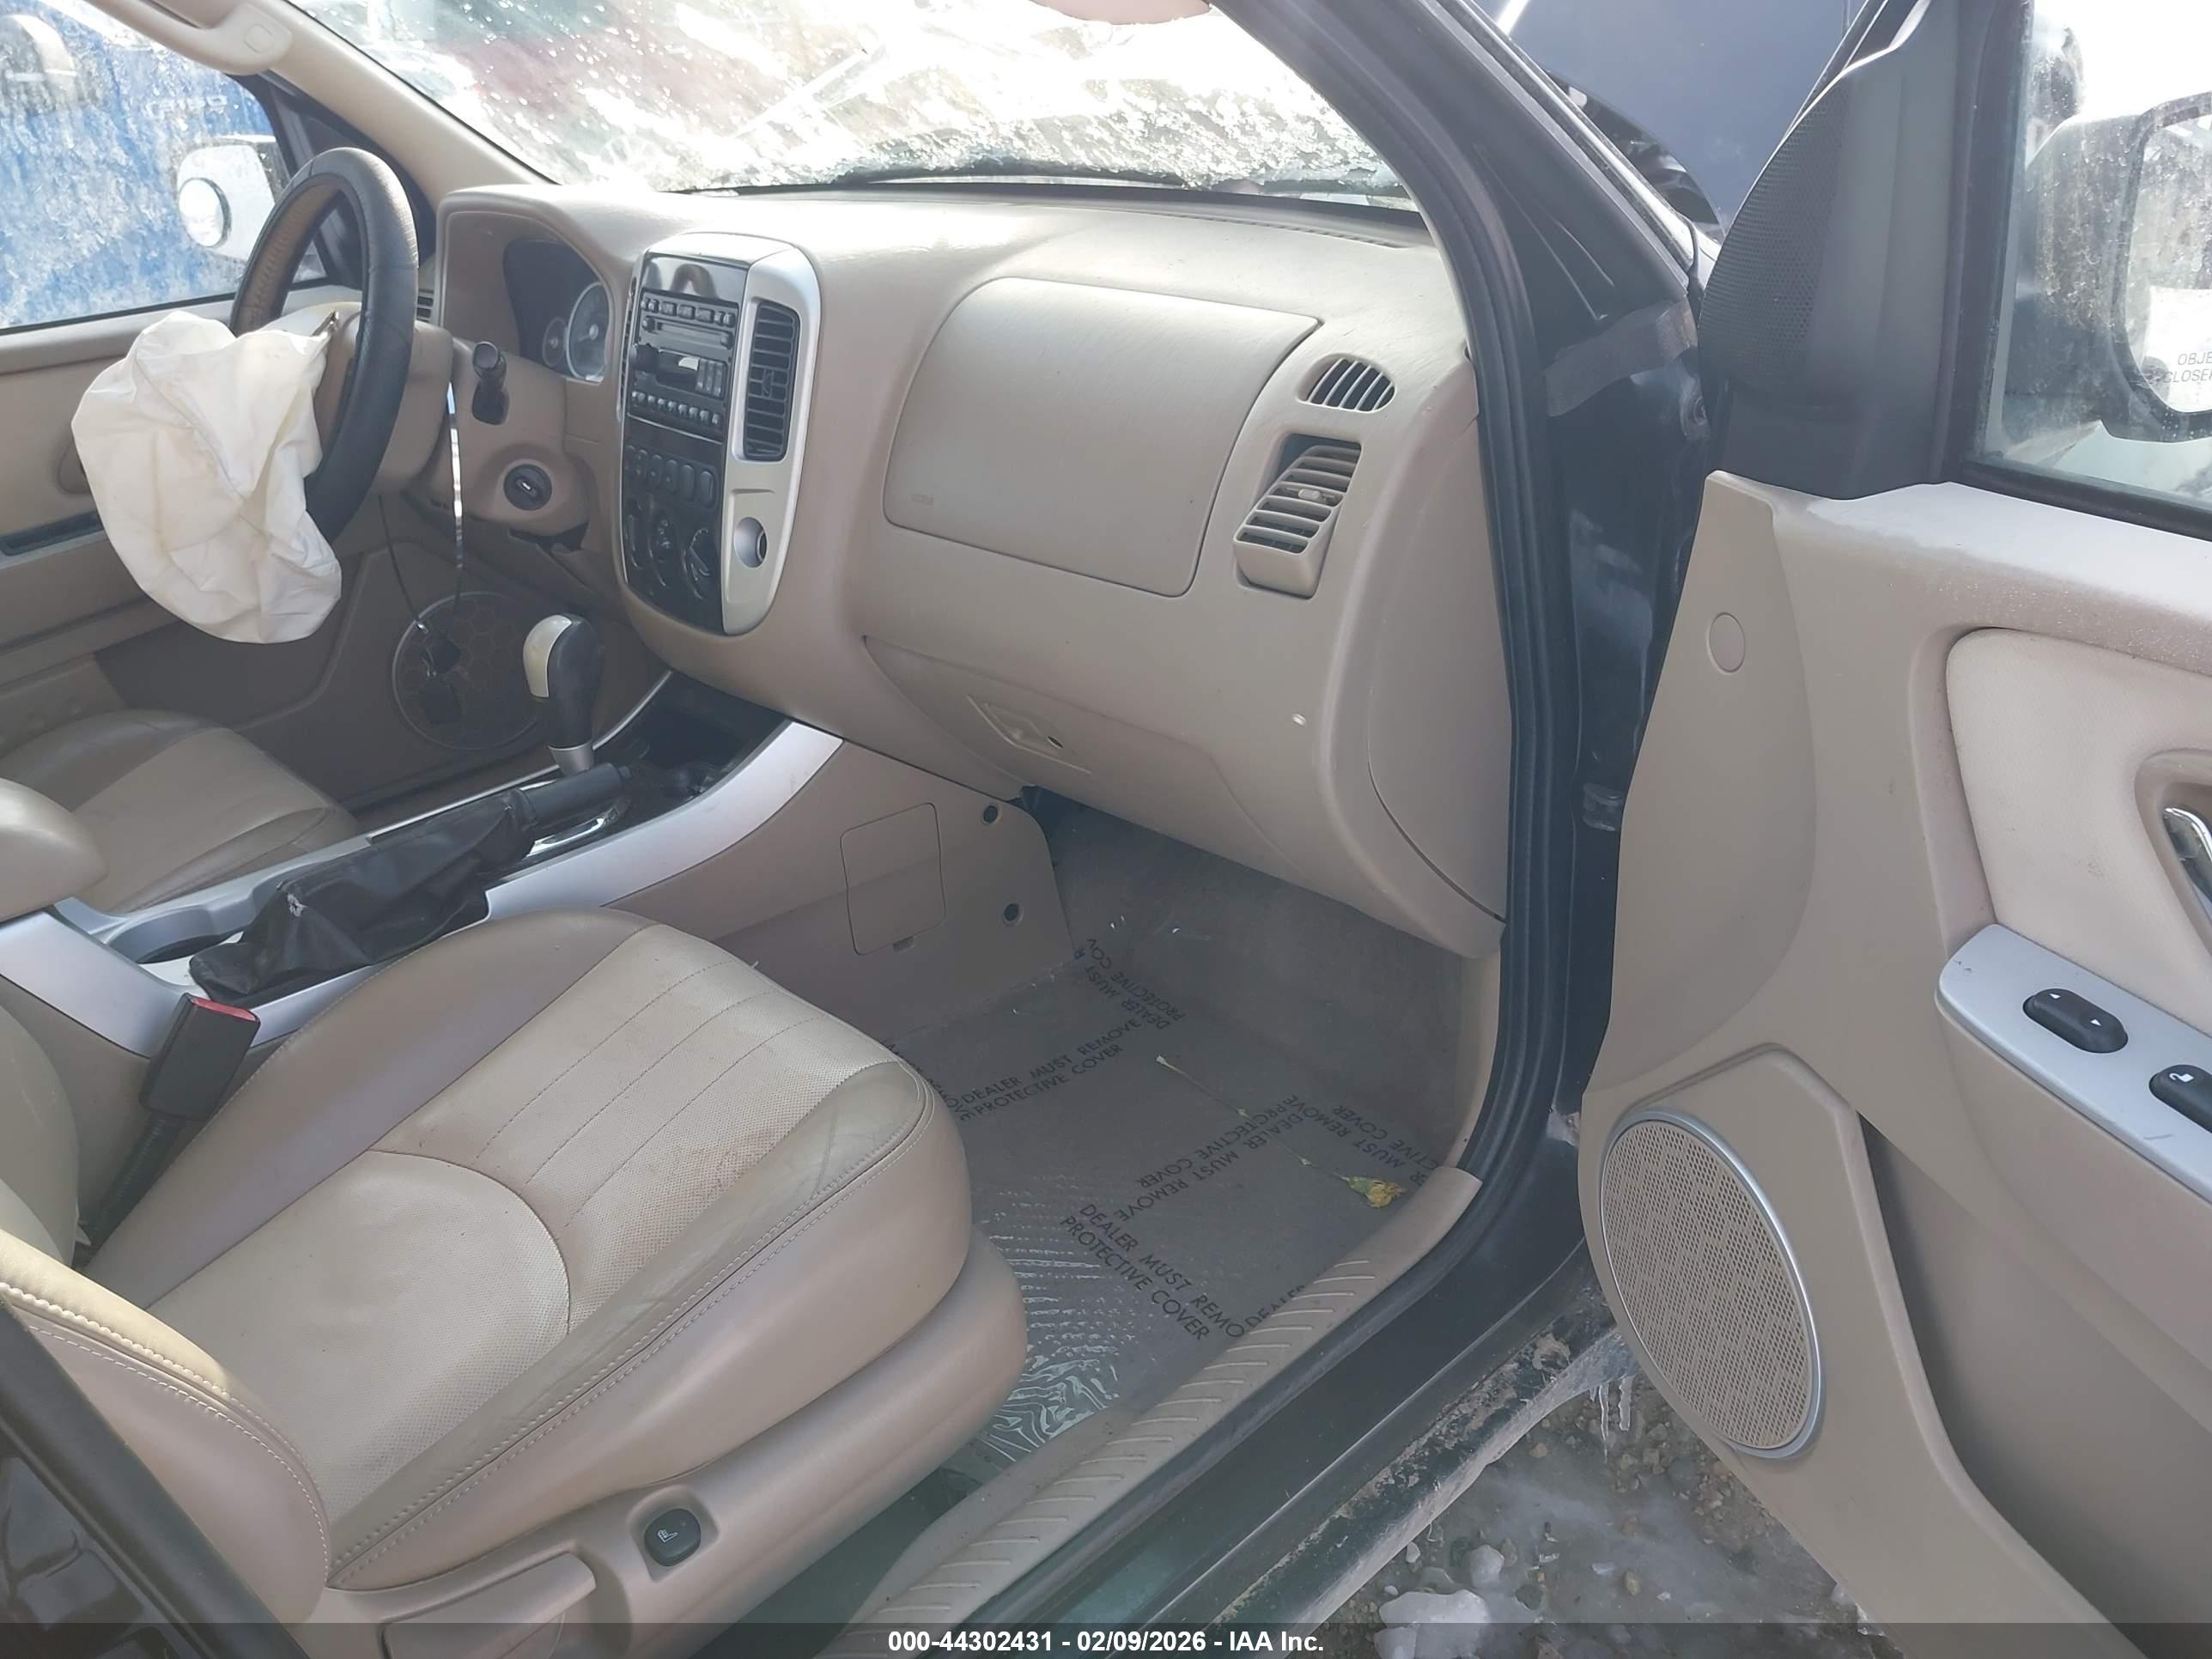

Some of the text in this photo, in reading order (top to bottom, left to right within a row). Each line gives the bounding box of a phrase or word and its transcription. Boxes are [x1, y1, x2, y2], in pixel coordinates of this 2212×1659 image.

[2177, 350, 2212, 366] OBJE
[1086, 938, 1113, 969] COV
[1084, 965, 1170, 1030] DEALER MUST
[961, 1018, 1142, 1105] DEALER MUST REMOVE
[974, 1043, 1123, 1115] PROTECTIVE COVER
[1134, 1103, 1288, 1188] PROTECTIVE COVER
[1282, 1094, 1406, 1169] MUST REMOVE
[1332, 1105, 1389, 1140] COVER
[1114, 1112, 1304, 1222] DEALER MUST REMOVE
[1060, 1215, 1210, 1340] PROTECTIVE COVER
[1079, 1203, 1245, 1338] DEALER MUST REMO
